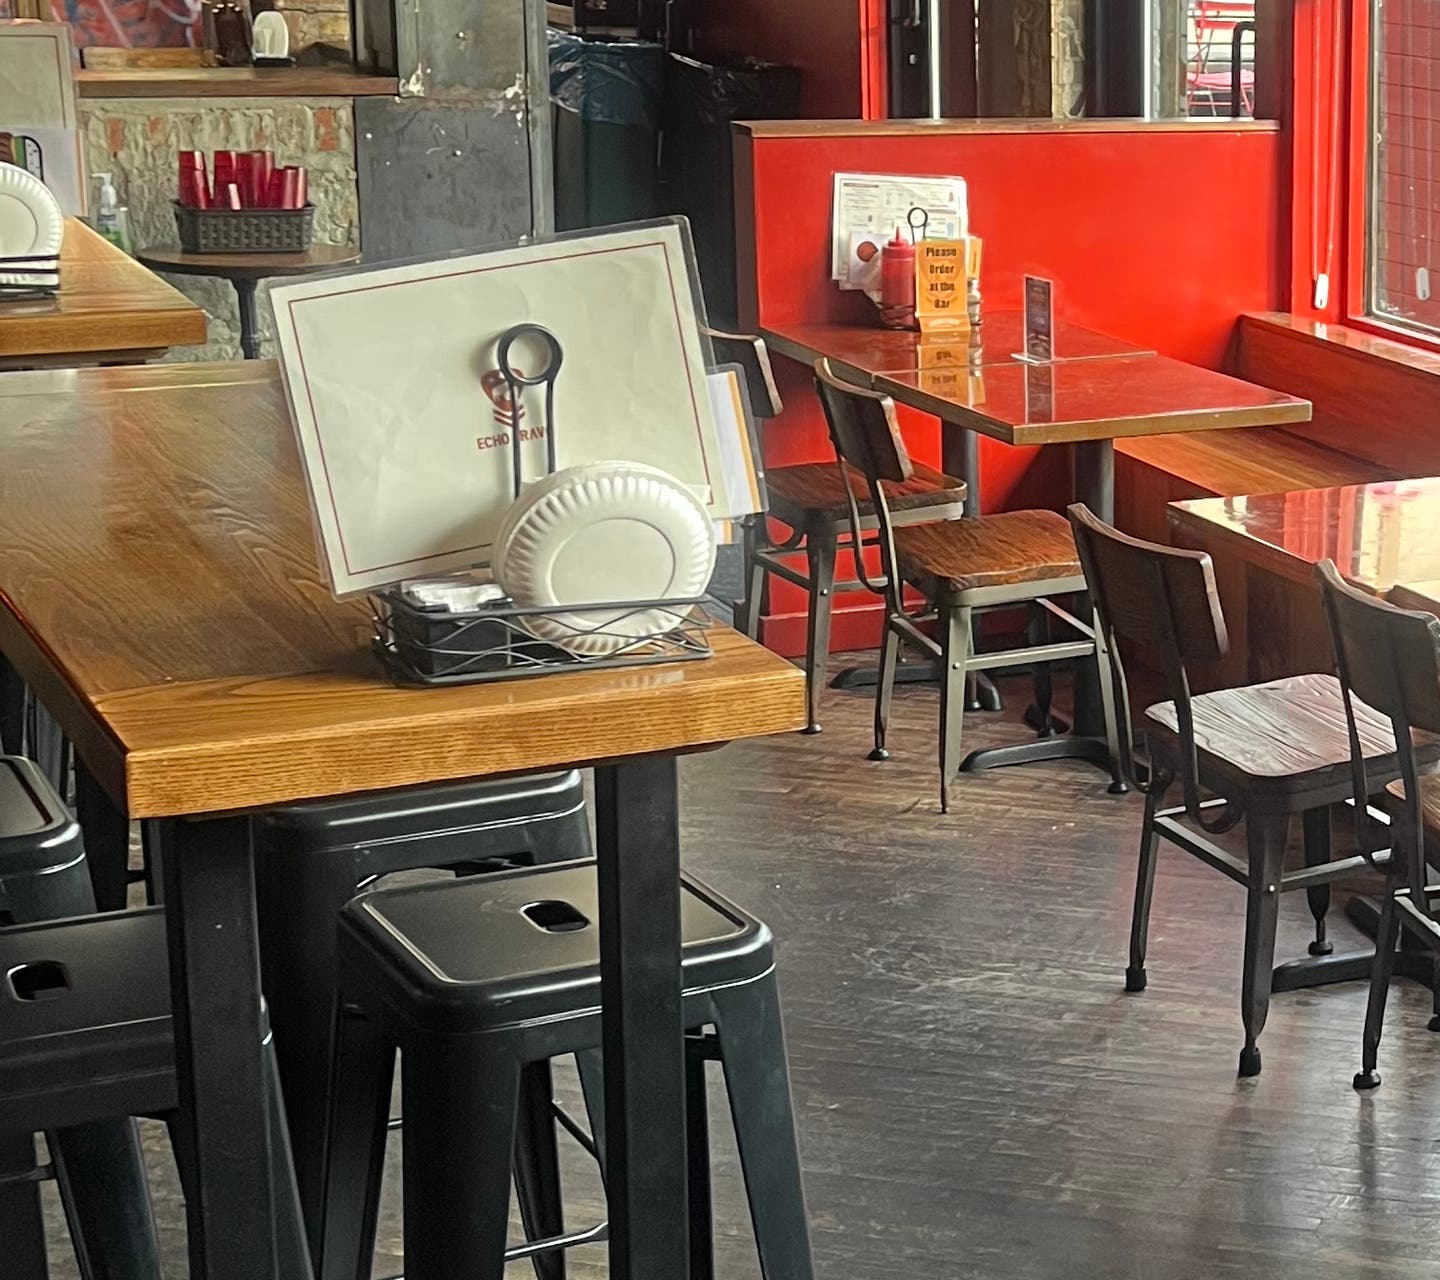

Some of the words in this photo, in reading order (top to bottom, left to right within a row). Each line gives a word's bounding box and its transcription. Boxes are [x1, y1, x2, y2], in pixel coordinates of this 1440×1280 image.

[926, 246, 957, 257] Please
[929, 263, 955, 274] Order
[929, 282, 938, 292] at
[940, 281, 955, 292] the
[934, 299, 951, 309] Bar
[476, 432, 510, 450] ECHO
[517, 426, 546, 442] RAV
